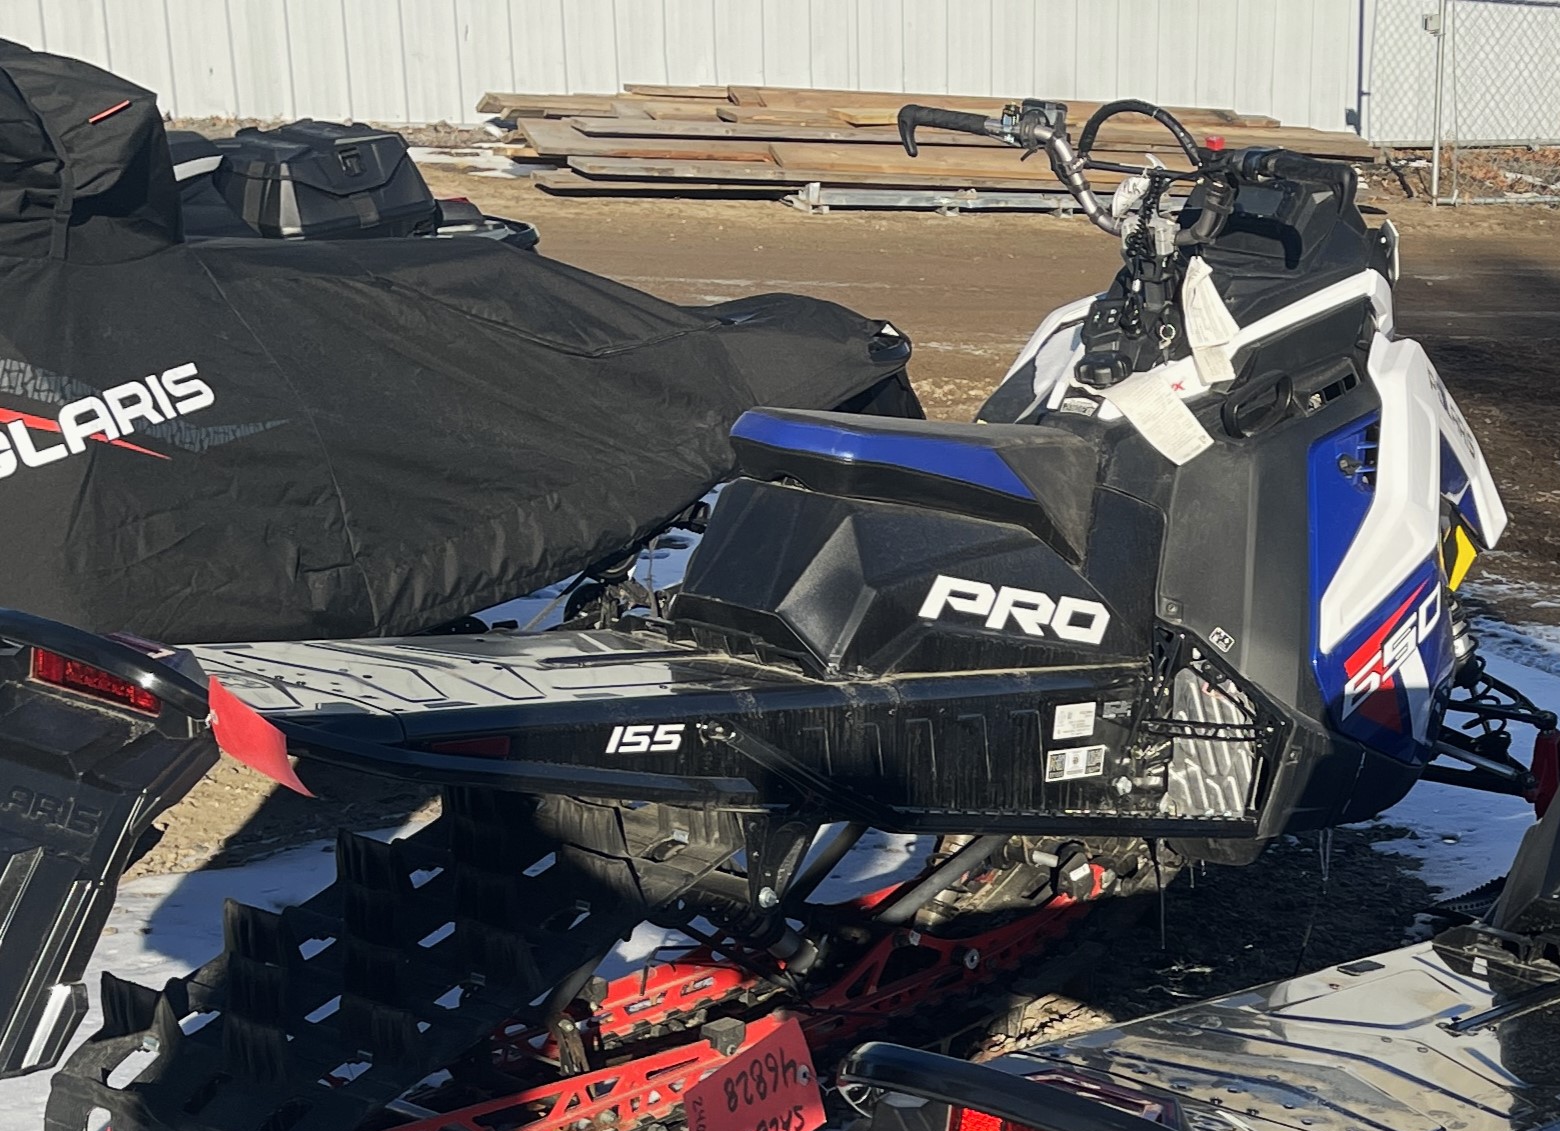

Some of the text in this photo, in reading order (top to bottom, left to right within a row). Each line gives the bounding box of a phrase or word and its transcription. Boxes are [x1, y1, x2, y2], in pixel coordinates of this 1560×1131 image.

[0, 362, 215, 480] LARIS
[919, 574, 1112, 645] PRO
[1341, 580, 1441, 722] 650
[605, 723, 686, 754] 155
[723, 1047, 798, 1113] 46828
